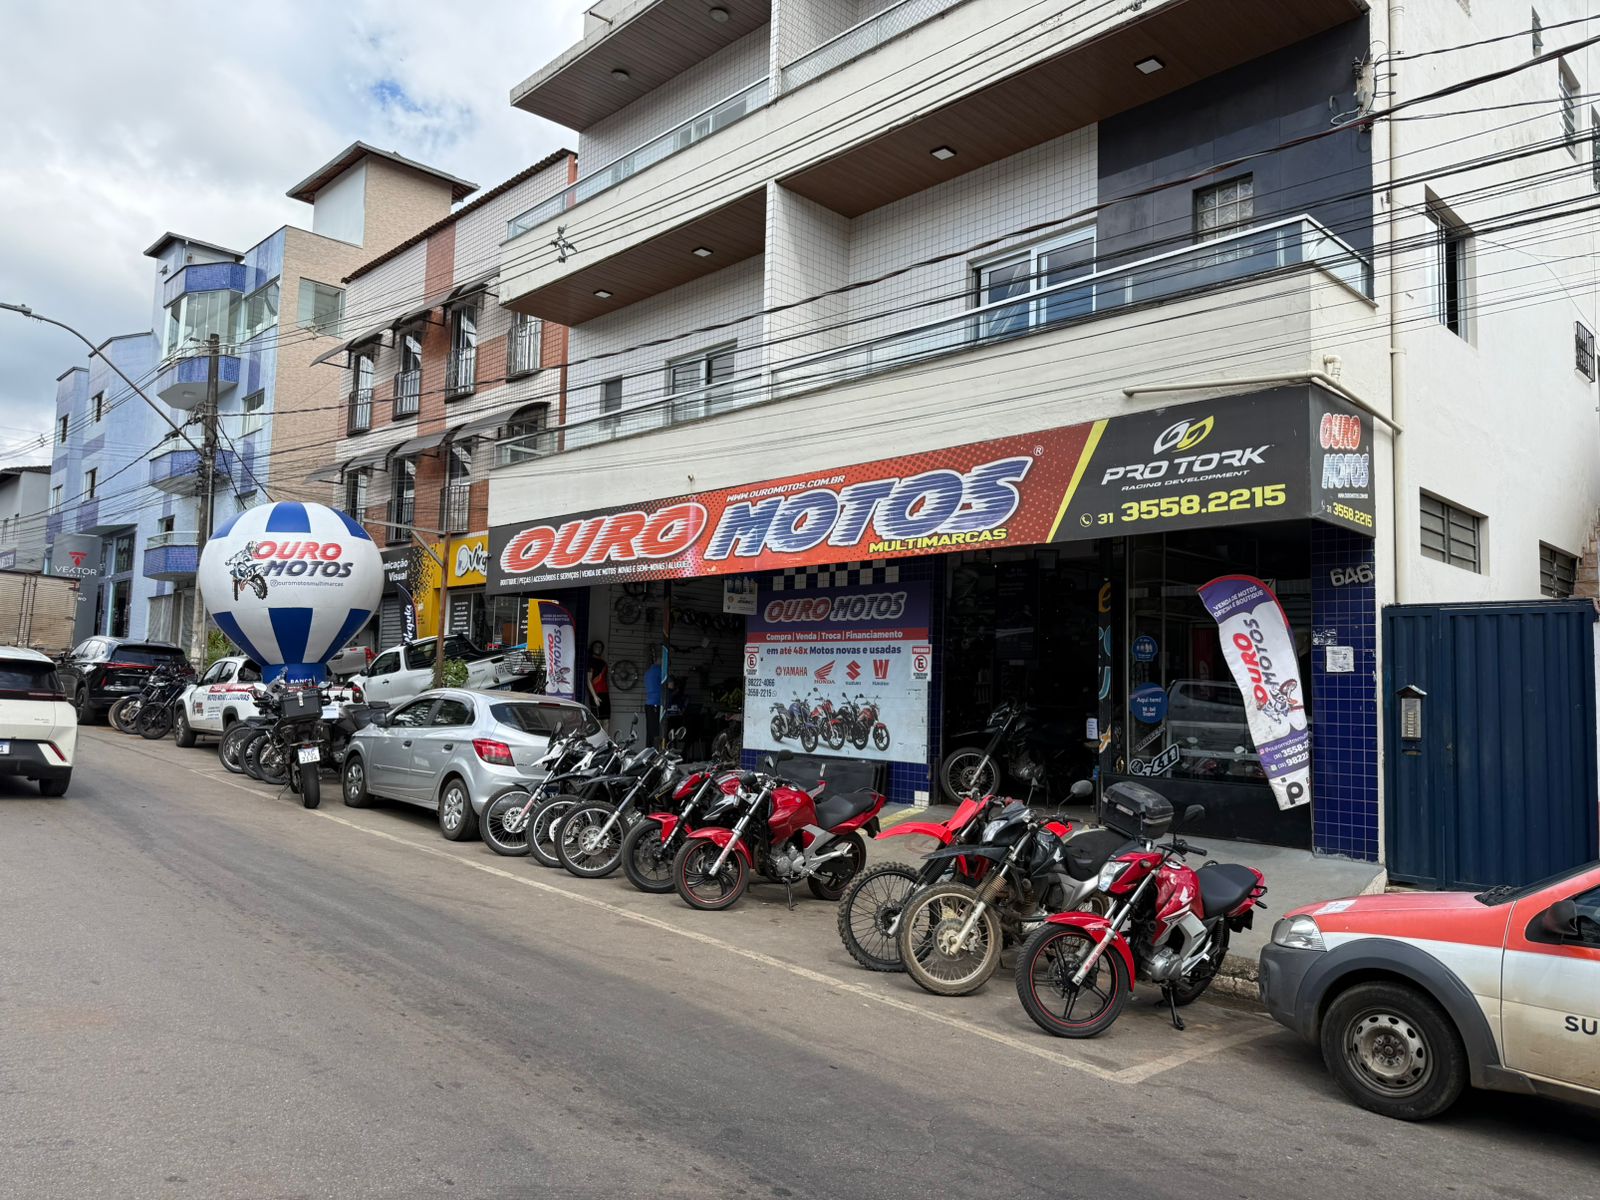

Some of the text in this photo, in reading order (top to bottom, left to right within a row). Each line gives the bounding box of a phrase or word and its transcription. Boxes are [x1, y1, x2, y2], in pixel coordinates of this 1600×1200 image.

[1320, 412, 1361, 450] OURO
[1101, 444, 1271, 486] PRO TORK
[1322, 453, 1370, 489] MOTOS
[726, 475, 846, 502] WWW.OUROMOTOS.COM.BR
[1121, 469, 1250, 492] RACING DEVELOPMENT
[500, 456, 1034, 573] OURO MOTOS
[1097, 484, 1286, 524] 31 3558.2215
[1332, 502, 1373, 526] 3558.2215
[252, 540, 343, 560] OURO
[869, 528, 1007, 553] MULTIMARCAS
[55, 565, 98, 576] VEKTOR
[263, 560, 353, 578] MOTOS
[389, 571, 407, 582] Visual
[1330, 564, 1374, 587] 646
[764, 591, 907, 623] OURO MOTOS
[766, 629, 903, 642] Compra Venda Troca Financiamento
[554, 628, 562, 669] MOTOS
[780, 646, 792, 655] até
[809, 646, 835, 655] Motos
[836, 647, 861, 655] novas
[869, 645, 902, 654] usadas
[1243, 618, 1279, 686] MOTOS
[783, 666, 808, 676] YAMAHA
[1233, 632, 1269, 705] OURO
[1564, 1015, 1598, 1036] SU
